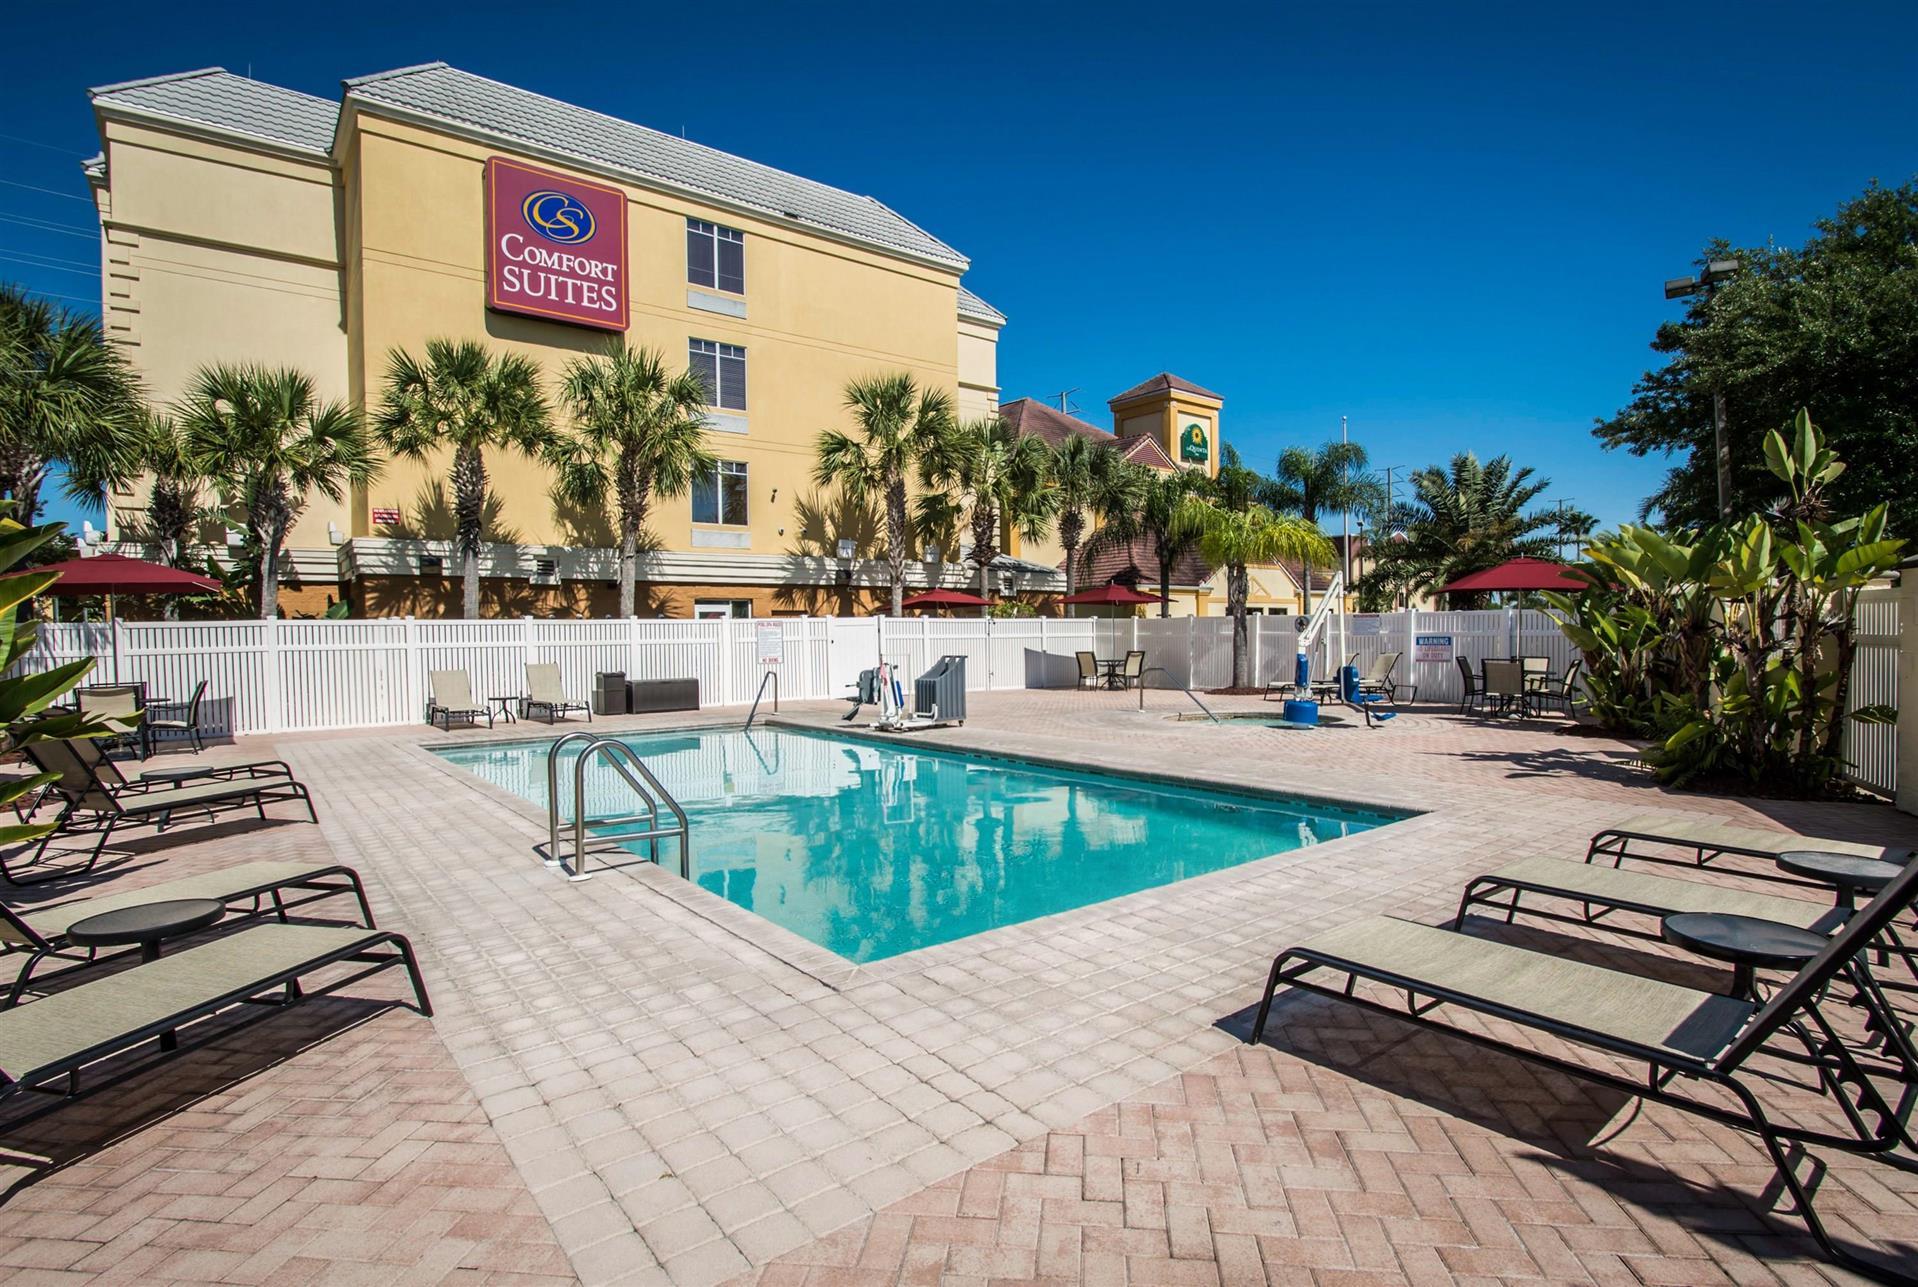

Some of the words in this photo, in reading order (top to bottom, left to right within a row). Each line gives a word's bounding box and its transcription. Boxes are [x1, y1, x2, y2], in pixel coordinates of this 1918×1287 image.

[501, 233, 618, 282] COMFORT
[503, 265, 618, 312] SUITES
[1418, 637, 1450, 645] WARNING
